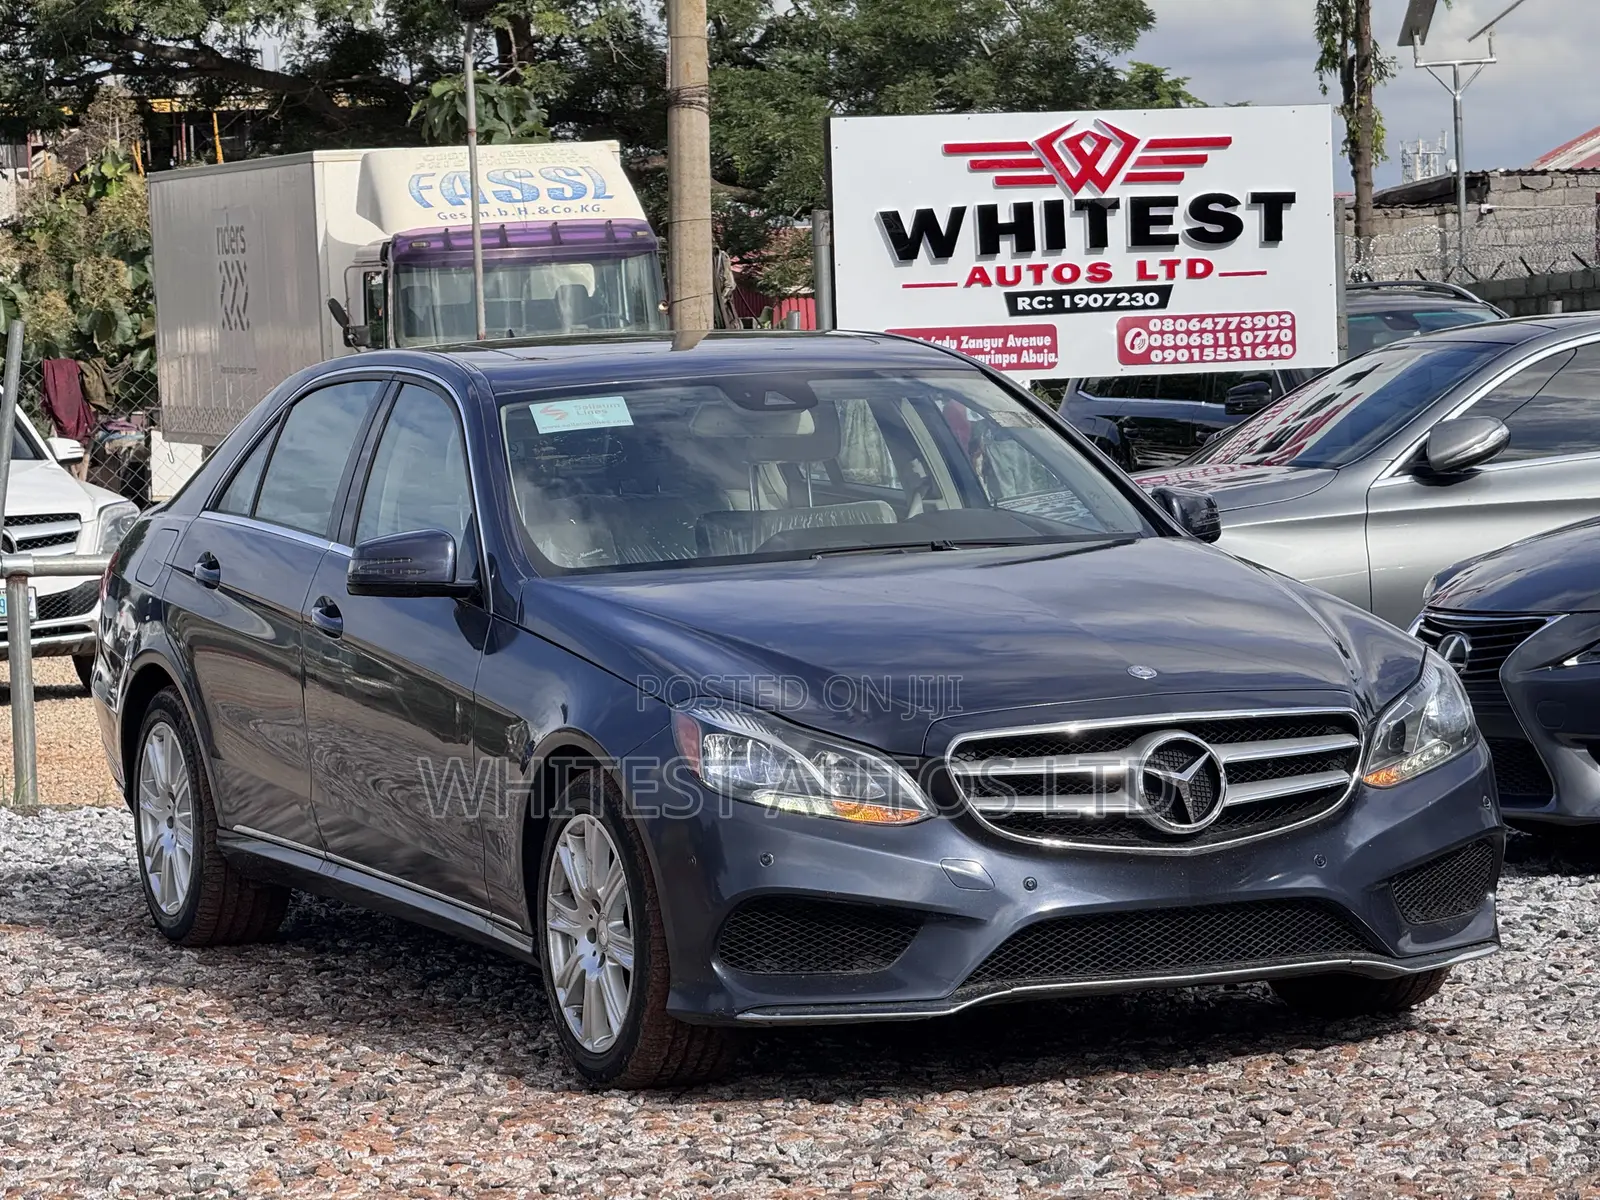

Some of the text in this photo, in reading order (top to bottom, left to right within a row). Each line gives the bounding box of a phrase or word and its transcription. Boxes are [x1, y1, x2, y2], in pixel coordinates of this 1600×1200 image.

[408, 166, 614, 209] FASSL
[216, 215, 246, 256] riders
[876, 191, 1296, 266] WHITEST
[963, 258, 1214, 289] AUTOS LTD
[1016, 292, 1160, 311] RC: 1907230
[1149, 314, 1293, 332] 08064773903
[960, 335, 1004, 352] Zangur
[1006, 334, 1052, 348] Avenue
[1149, 328, 1293, 347] 08068110770
[1020, 349, 1059, 367] Abuja.
[1150, 343, 1295, 363] 09015531640
